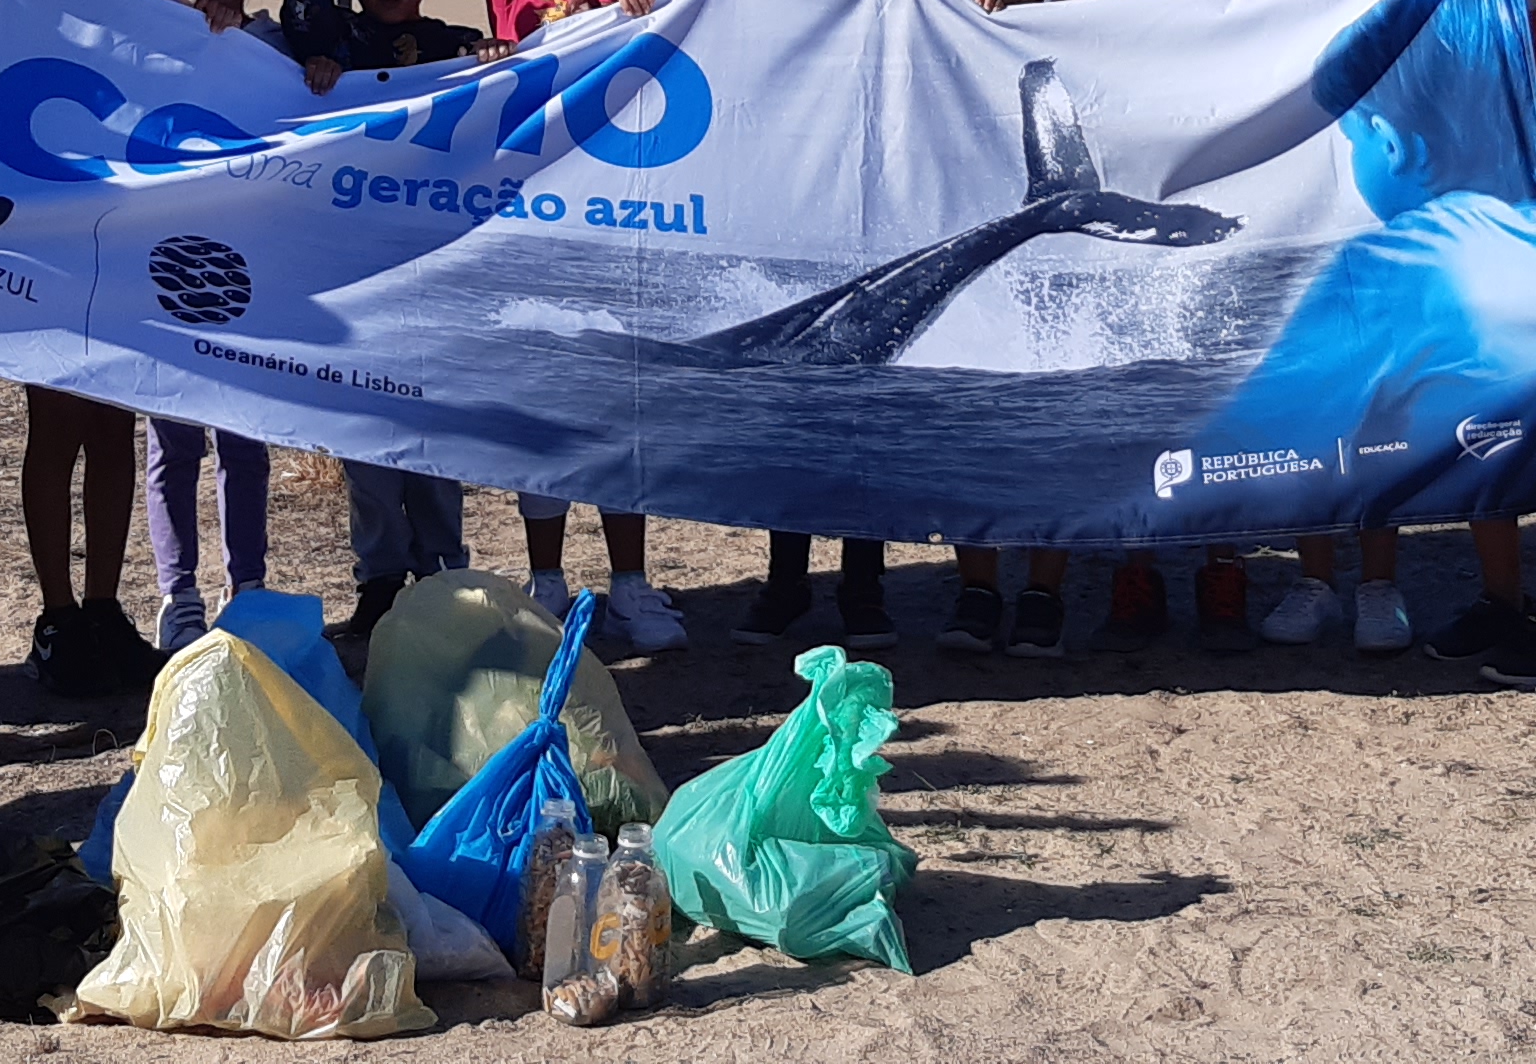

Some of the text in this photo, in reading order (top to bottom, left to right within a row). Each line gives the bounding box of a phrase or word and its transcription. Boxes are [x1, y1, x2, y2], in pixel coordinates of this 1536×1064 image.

[226, 154, 708, 235] uma geração azul
[193, 338, 424, 398] Oceanário de Lisboa
[1201, 449, 1299, 471] REPÚBLICA
[1358, 441, 1409, 456] EDUCAÇÃO
[1202, 458, 1324, 485] PORTUGUESA
